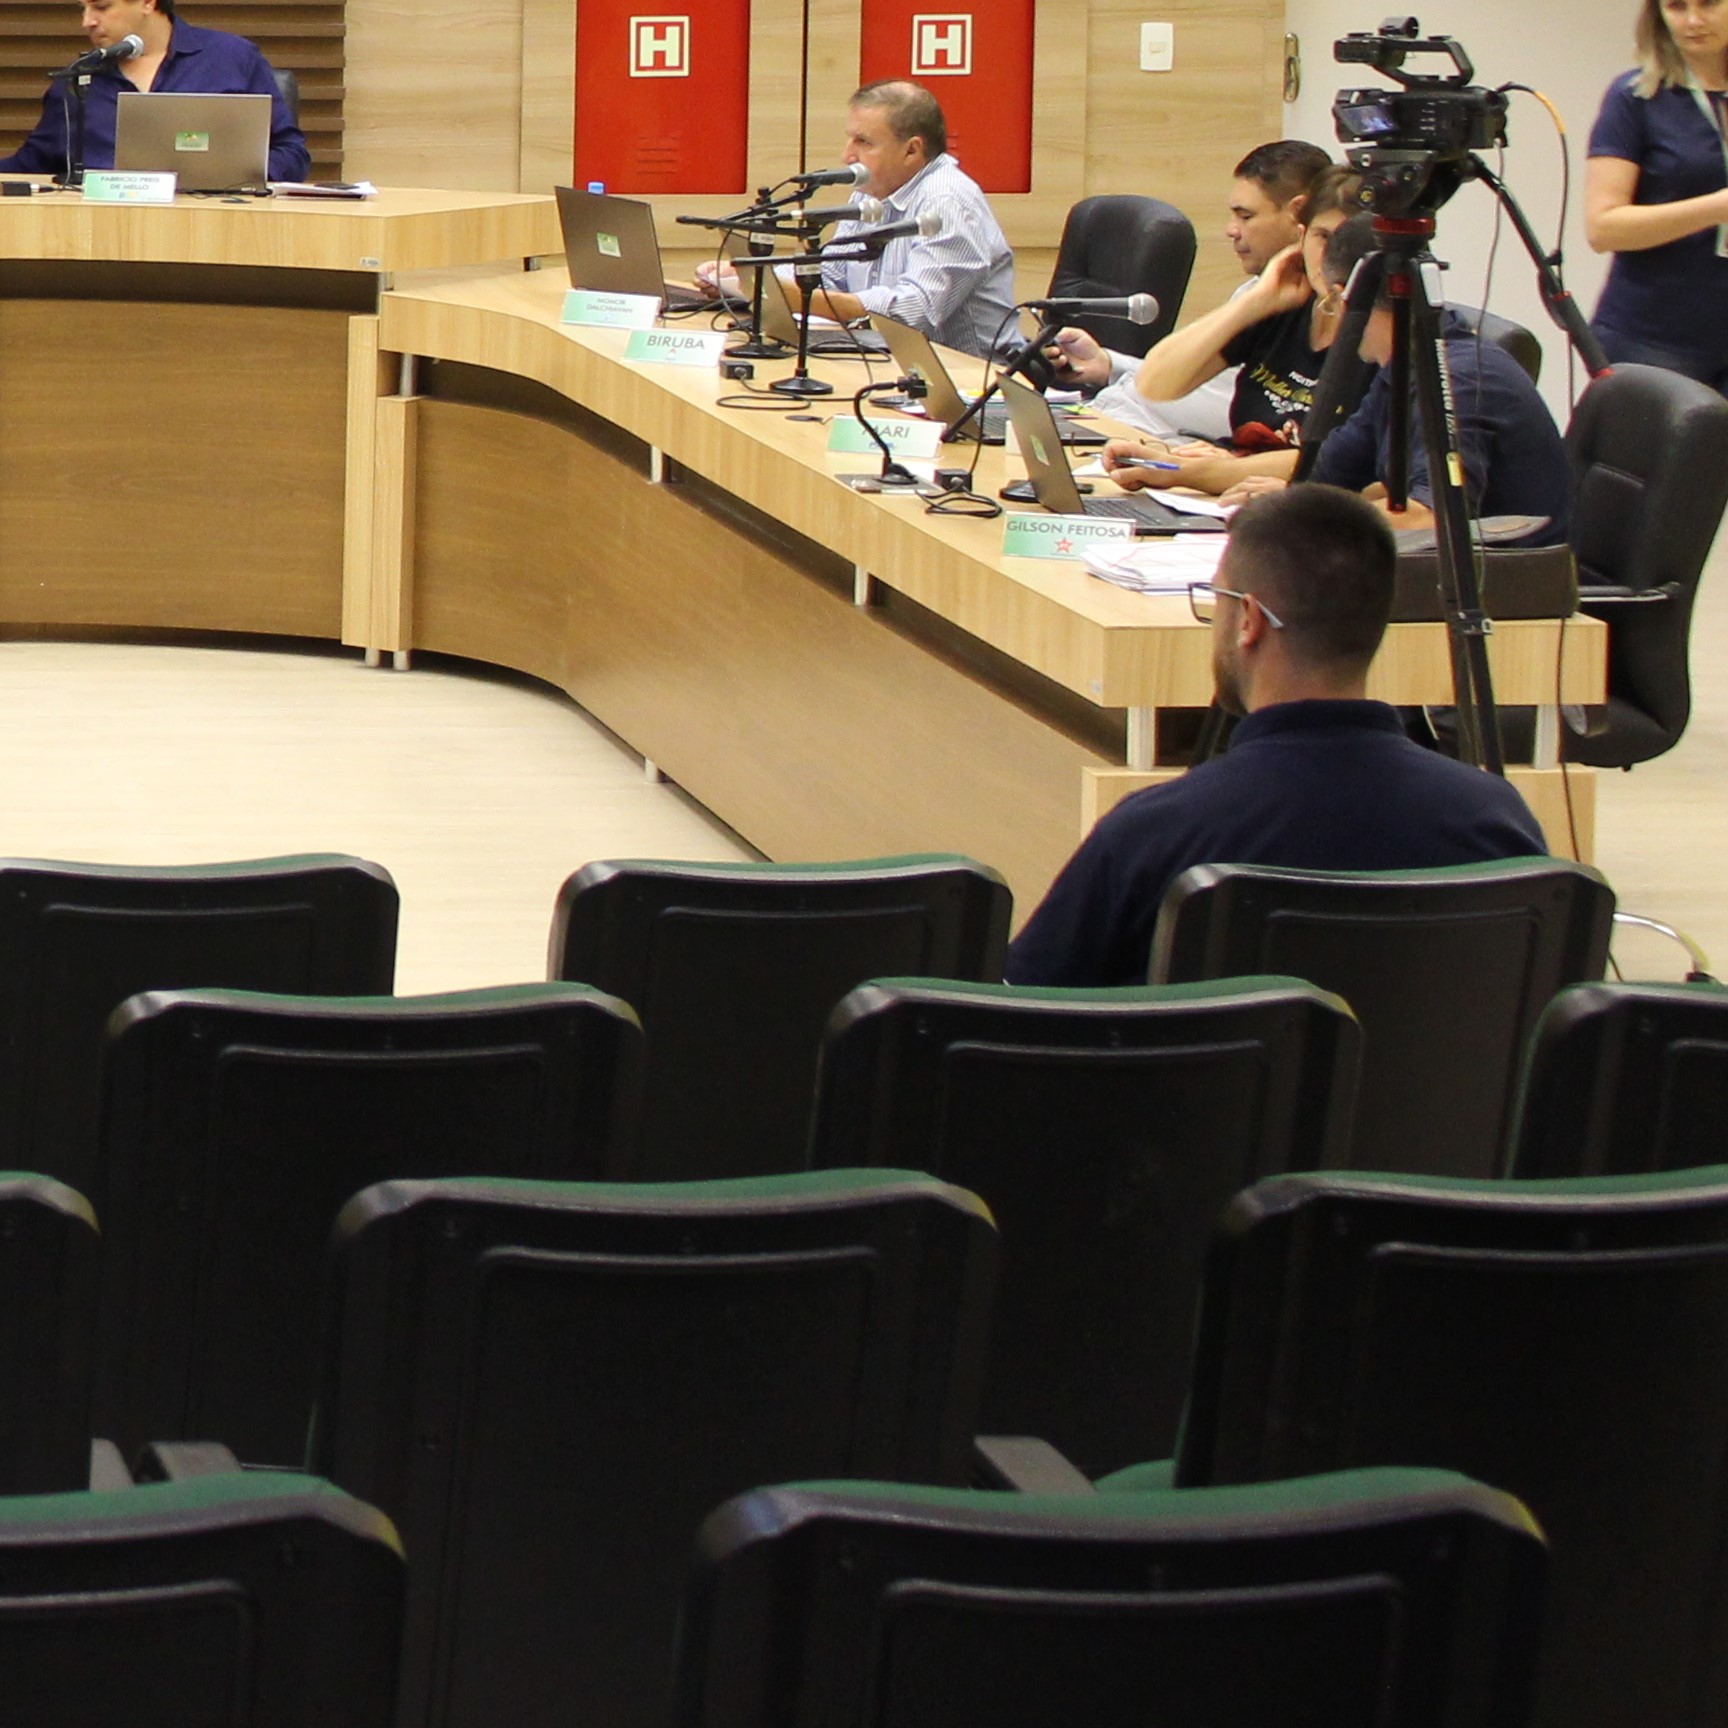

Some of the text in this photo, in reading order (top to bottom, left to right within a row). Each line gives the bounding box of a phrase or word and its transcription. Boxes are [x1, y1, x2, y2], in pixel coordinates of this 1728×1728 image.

[640, 26, 680, 68] H
[921, 24, 962, 66] H
[110, 183, 121, 191] DE
[646, 335, 706, 350] BIRUBA
[1007, 520, 1126, 538] GILSON FEITOSA
